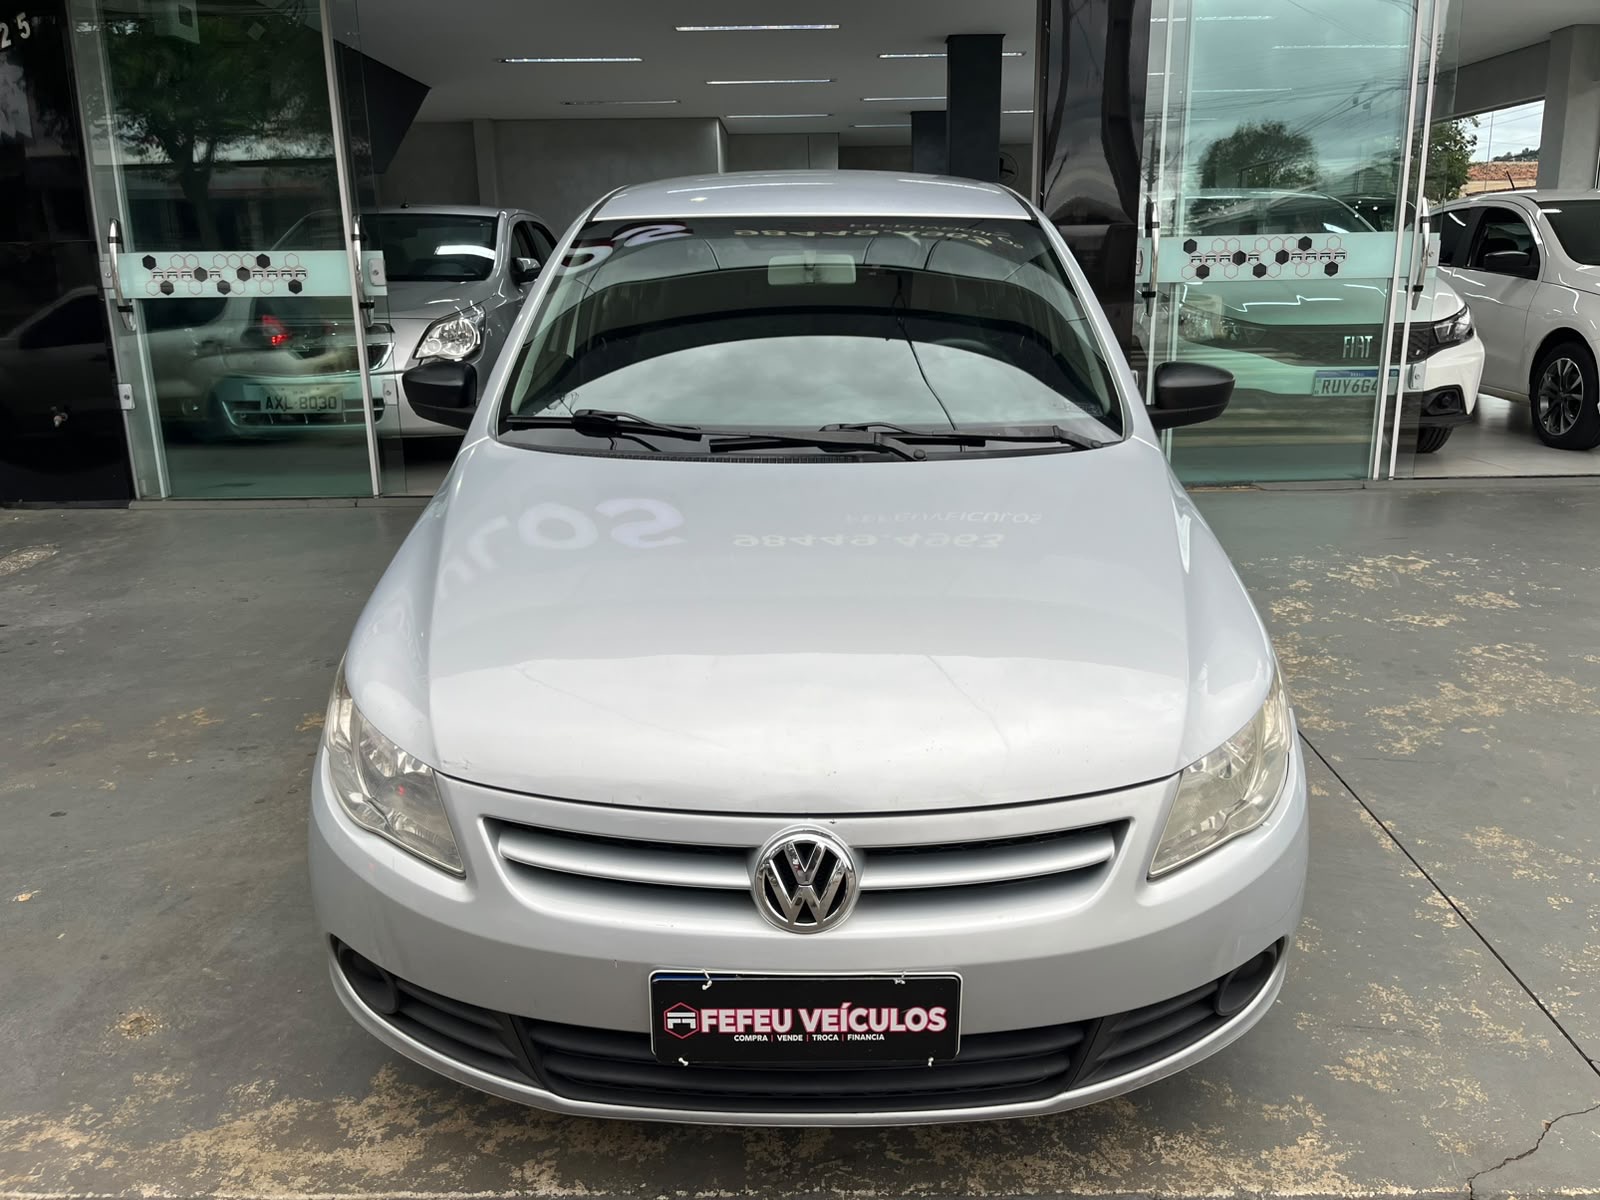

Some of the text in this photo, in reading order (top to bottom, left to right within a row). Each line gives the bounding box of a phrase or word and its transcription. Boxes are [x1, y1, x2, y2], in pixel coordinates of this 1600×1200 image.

[1343, 335, 1373, 358] FIAT
[1321, 379, 1379, 394] RUY6G4
[265, 396, 337, 410] AXL 8030
[760, 834, 850, 930] VW
[700, 1002, 947, 1033] FEFEU VEÍCULOS
[733, 1034, 768, 1042] COMPRA
[777, 1034, 803, 1042] VENDE
[812, 1034, 839, 1042] TROCA
